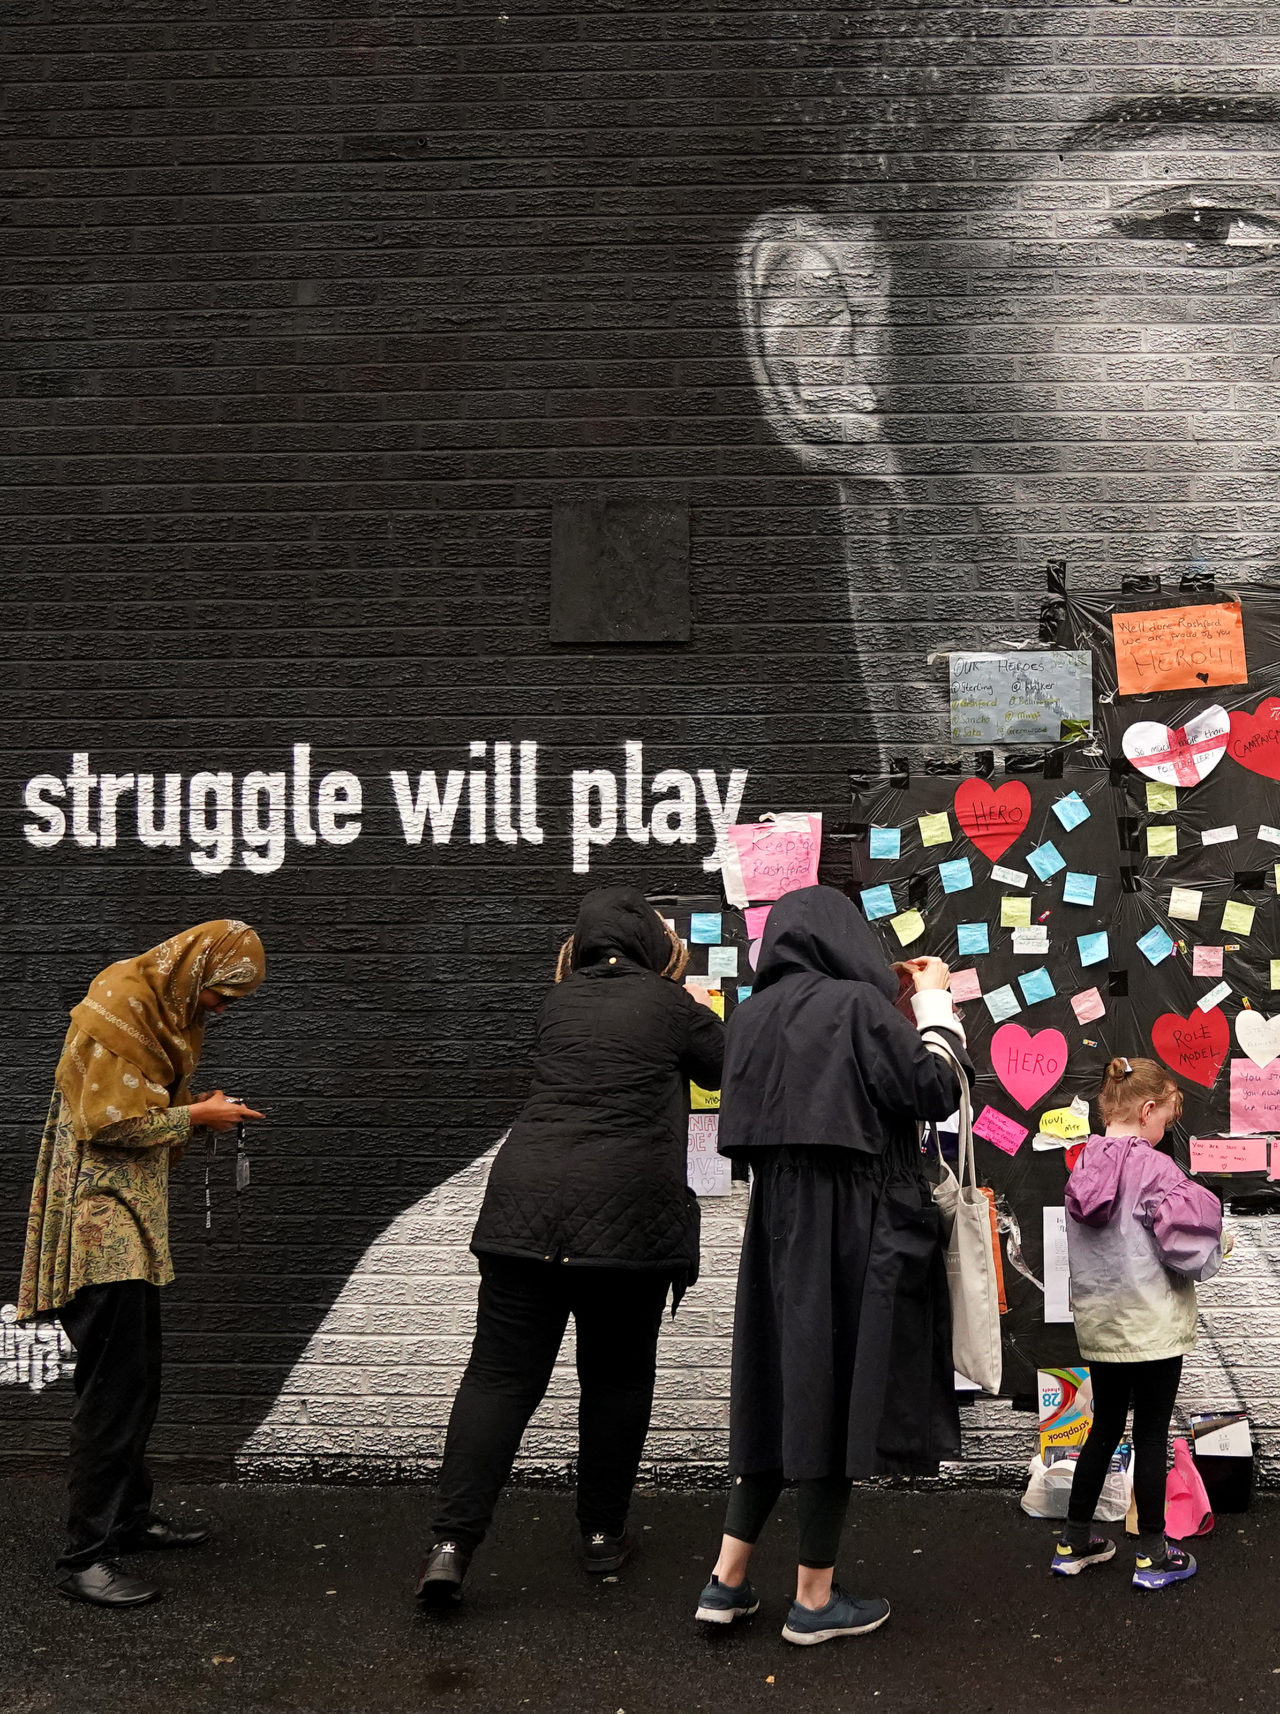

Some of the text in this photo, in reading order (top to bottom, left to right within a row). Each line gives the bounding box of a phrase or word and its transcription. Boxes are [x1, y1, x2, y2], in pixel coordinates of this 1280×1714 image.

[1117, 621, 1145, 633] Well
[23, 740, 749, 875] struggle will play
[973, 802, 1022, 832] HERO
[1173, 1024, 1211, 1050] ROLE
[1007, 1047, 1058, 1077] HERO
[1180, 1045, 1221, 1069] MODEL
[1042, 1393, 1061, 1407] 28
[1048, 1420, 1090, 1443] scrapbook
